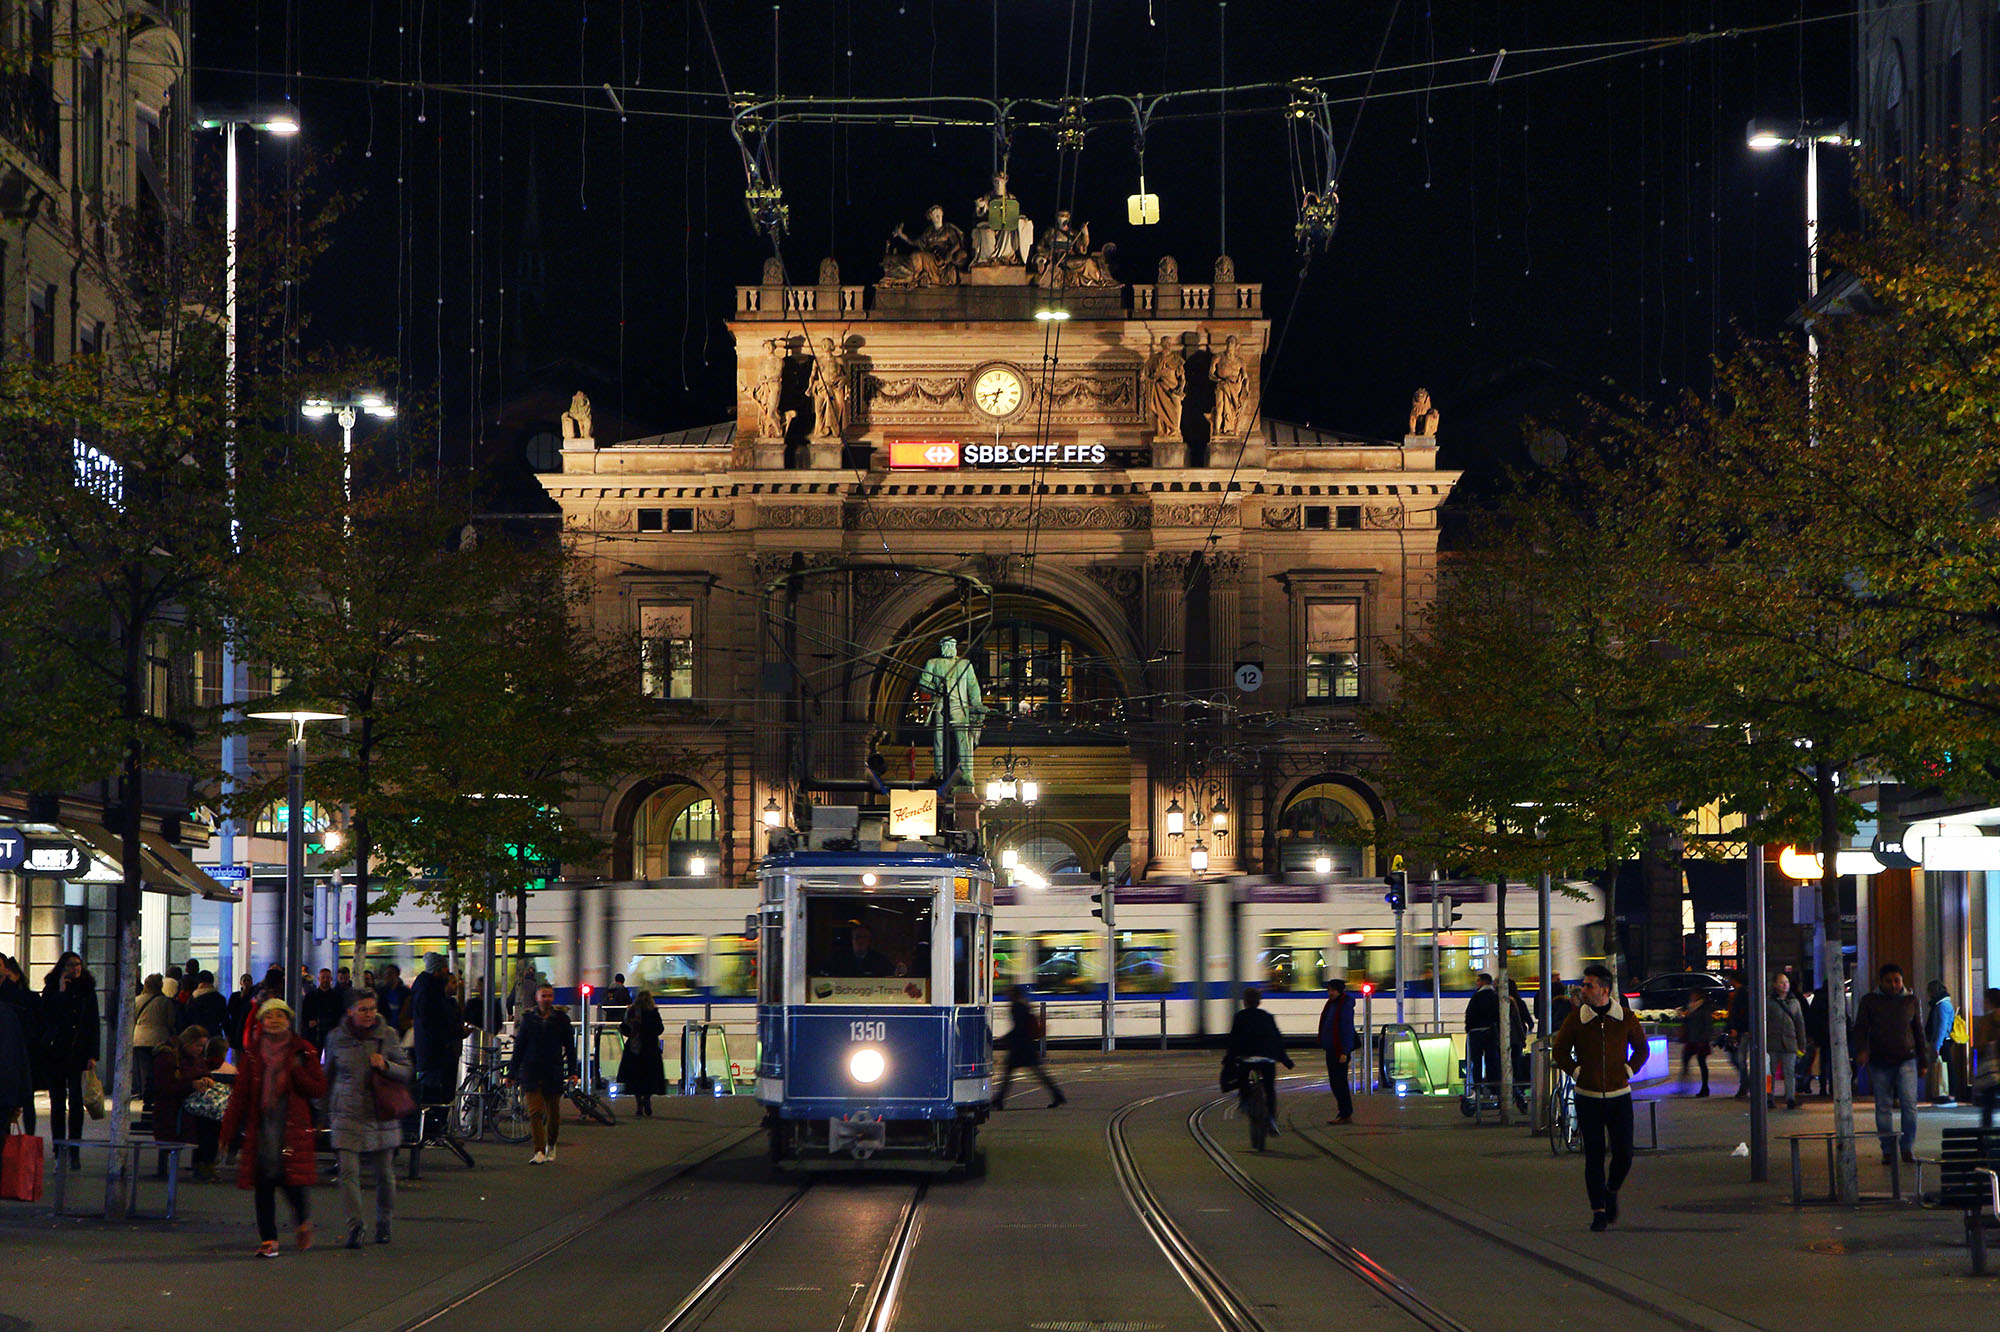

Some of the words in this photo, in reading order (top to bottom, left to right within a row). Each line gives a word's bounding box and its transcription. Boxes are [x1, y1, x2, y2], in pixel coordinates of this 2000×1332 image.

[964, 444, 1009, 463] SBB
[1014, 444, 1059, 463] CFF
[1064, 444, 1106, 463] FFS
[1241, 671, 1257, 685] 12
[849, 1021, 886, 1041] 1350
